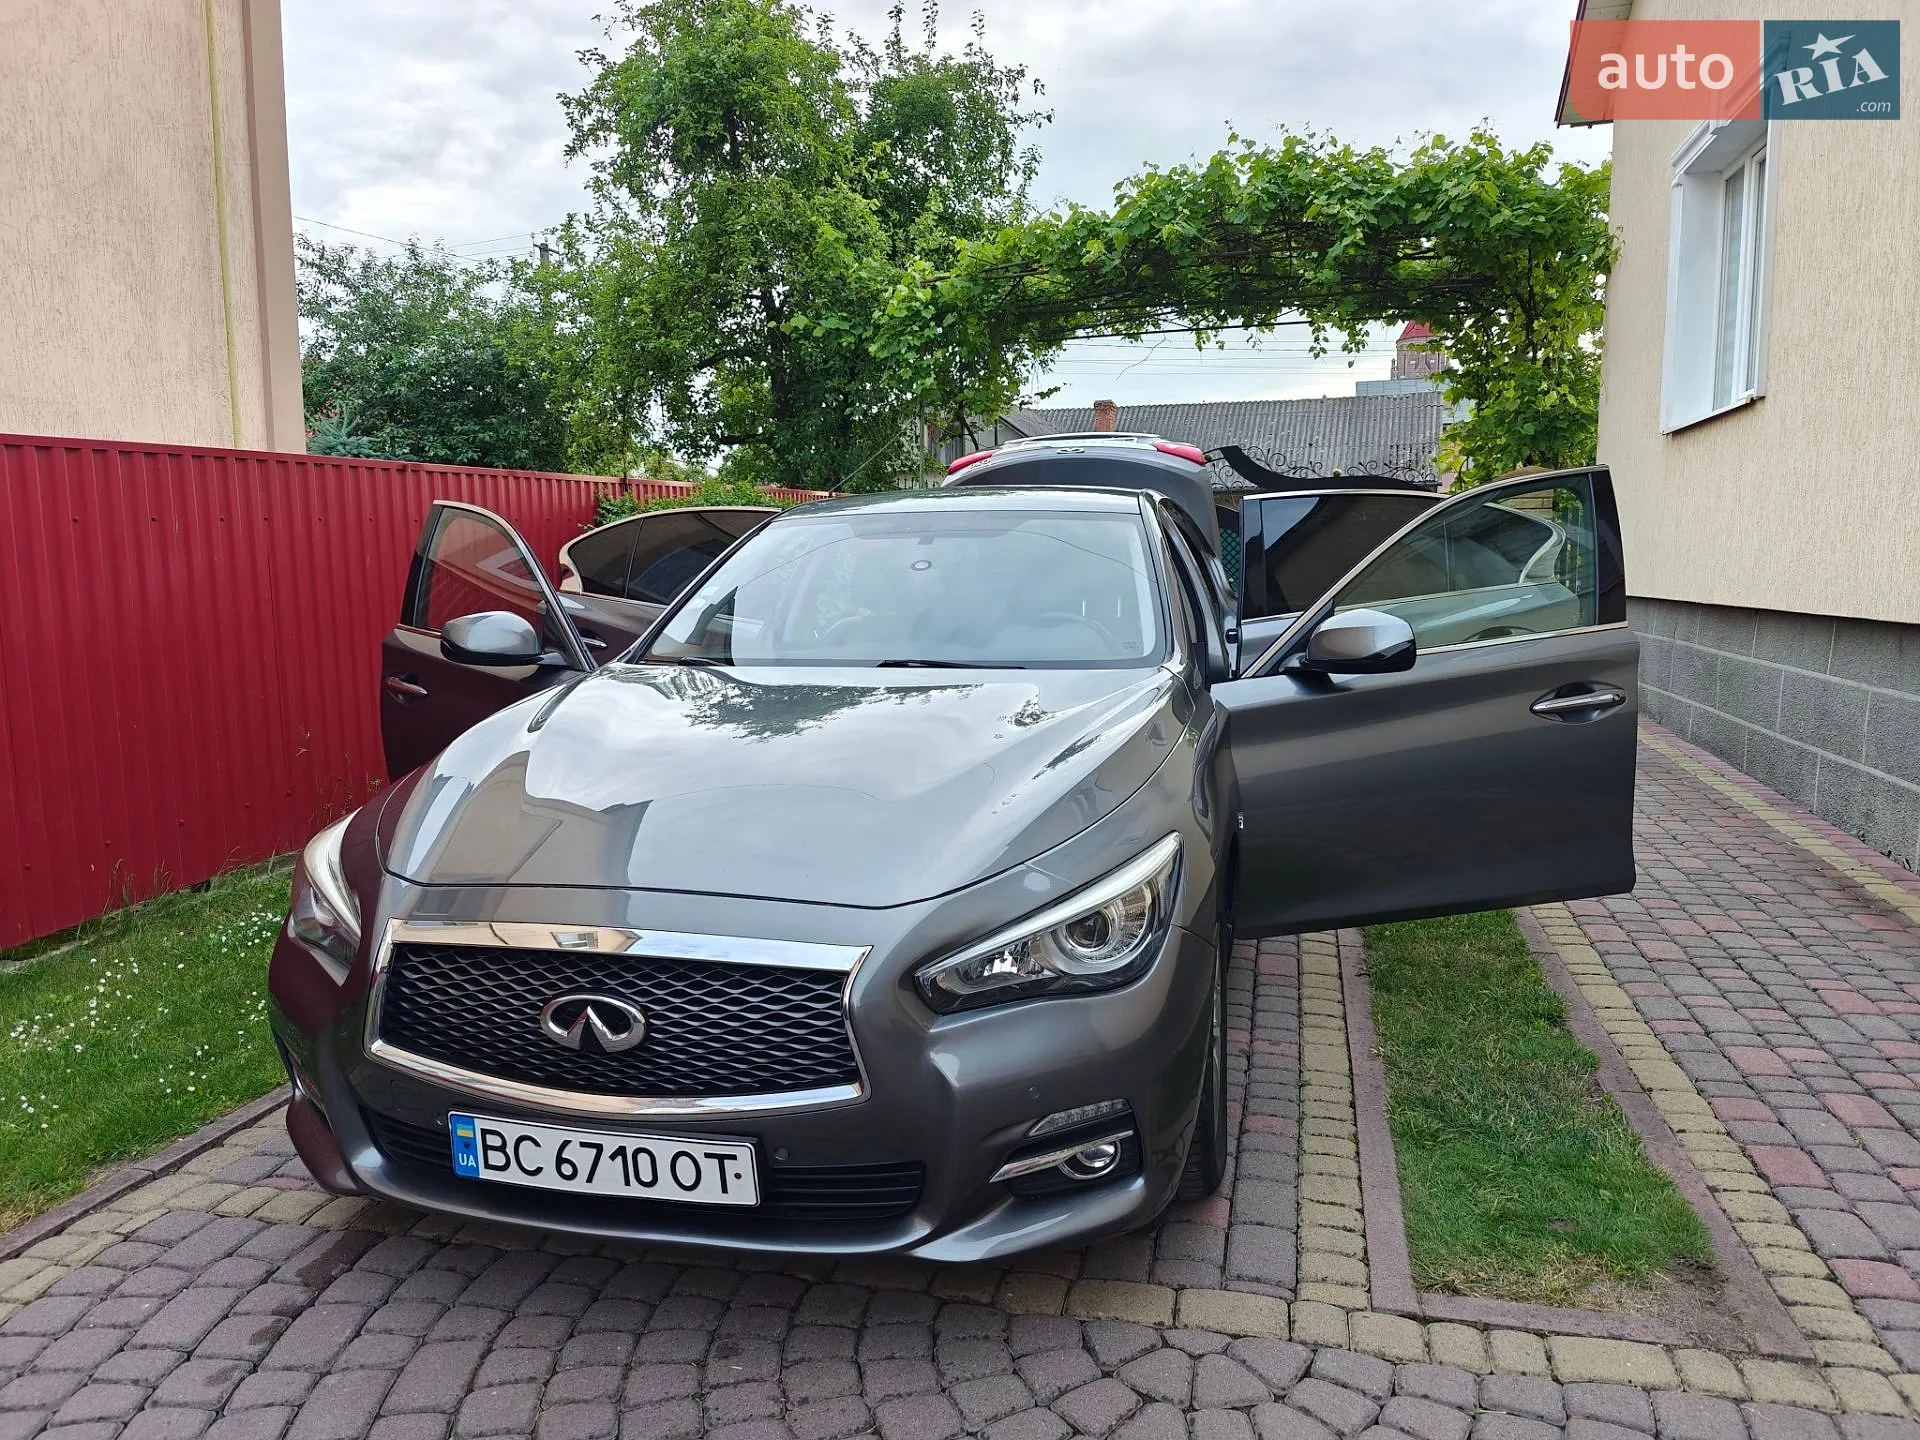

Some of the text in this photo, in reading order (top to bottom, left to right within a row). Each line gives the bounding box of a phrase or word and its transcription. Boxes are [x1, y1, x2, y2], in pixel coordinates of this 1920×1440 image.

[458, 1152, 477, 1168] UA
[480, 1127, 738, 1194] BC 6710 OT
